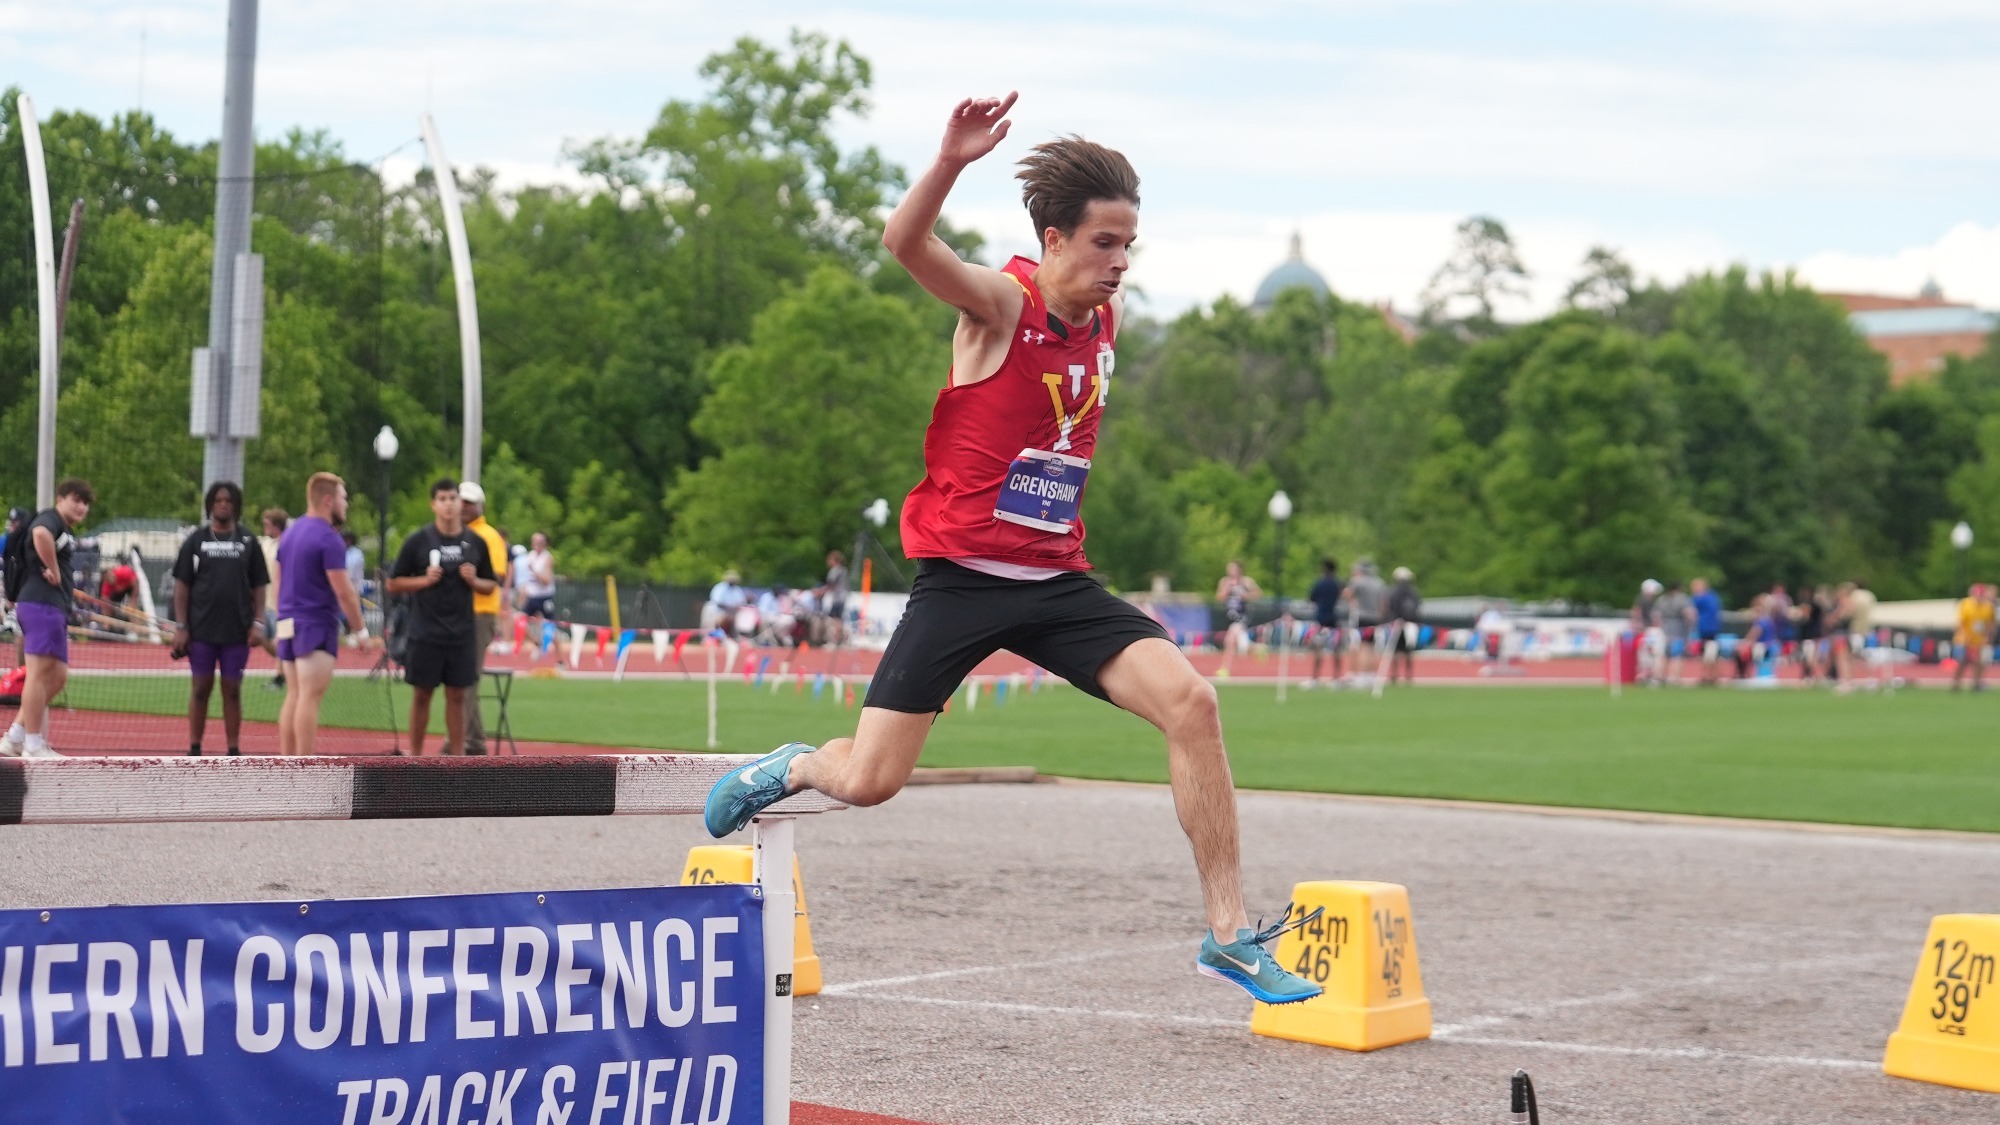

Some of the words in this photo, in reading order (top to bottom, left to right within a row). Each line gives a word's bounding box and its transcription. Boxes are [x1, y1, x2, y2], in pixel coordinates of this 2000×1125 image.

[1009, 473, 1079, 503] CRENSHAW
[1294, 904, 1349, 945] 14m
[234, 916, 739, 1053] CONFERENCE
[1933, 938, 1995, 985] 12m
[336, 1067, 528, 1125] TRACK
[535, 1064, 576, 1125] &
[590, 1054, 739, 1125] FIELD
